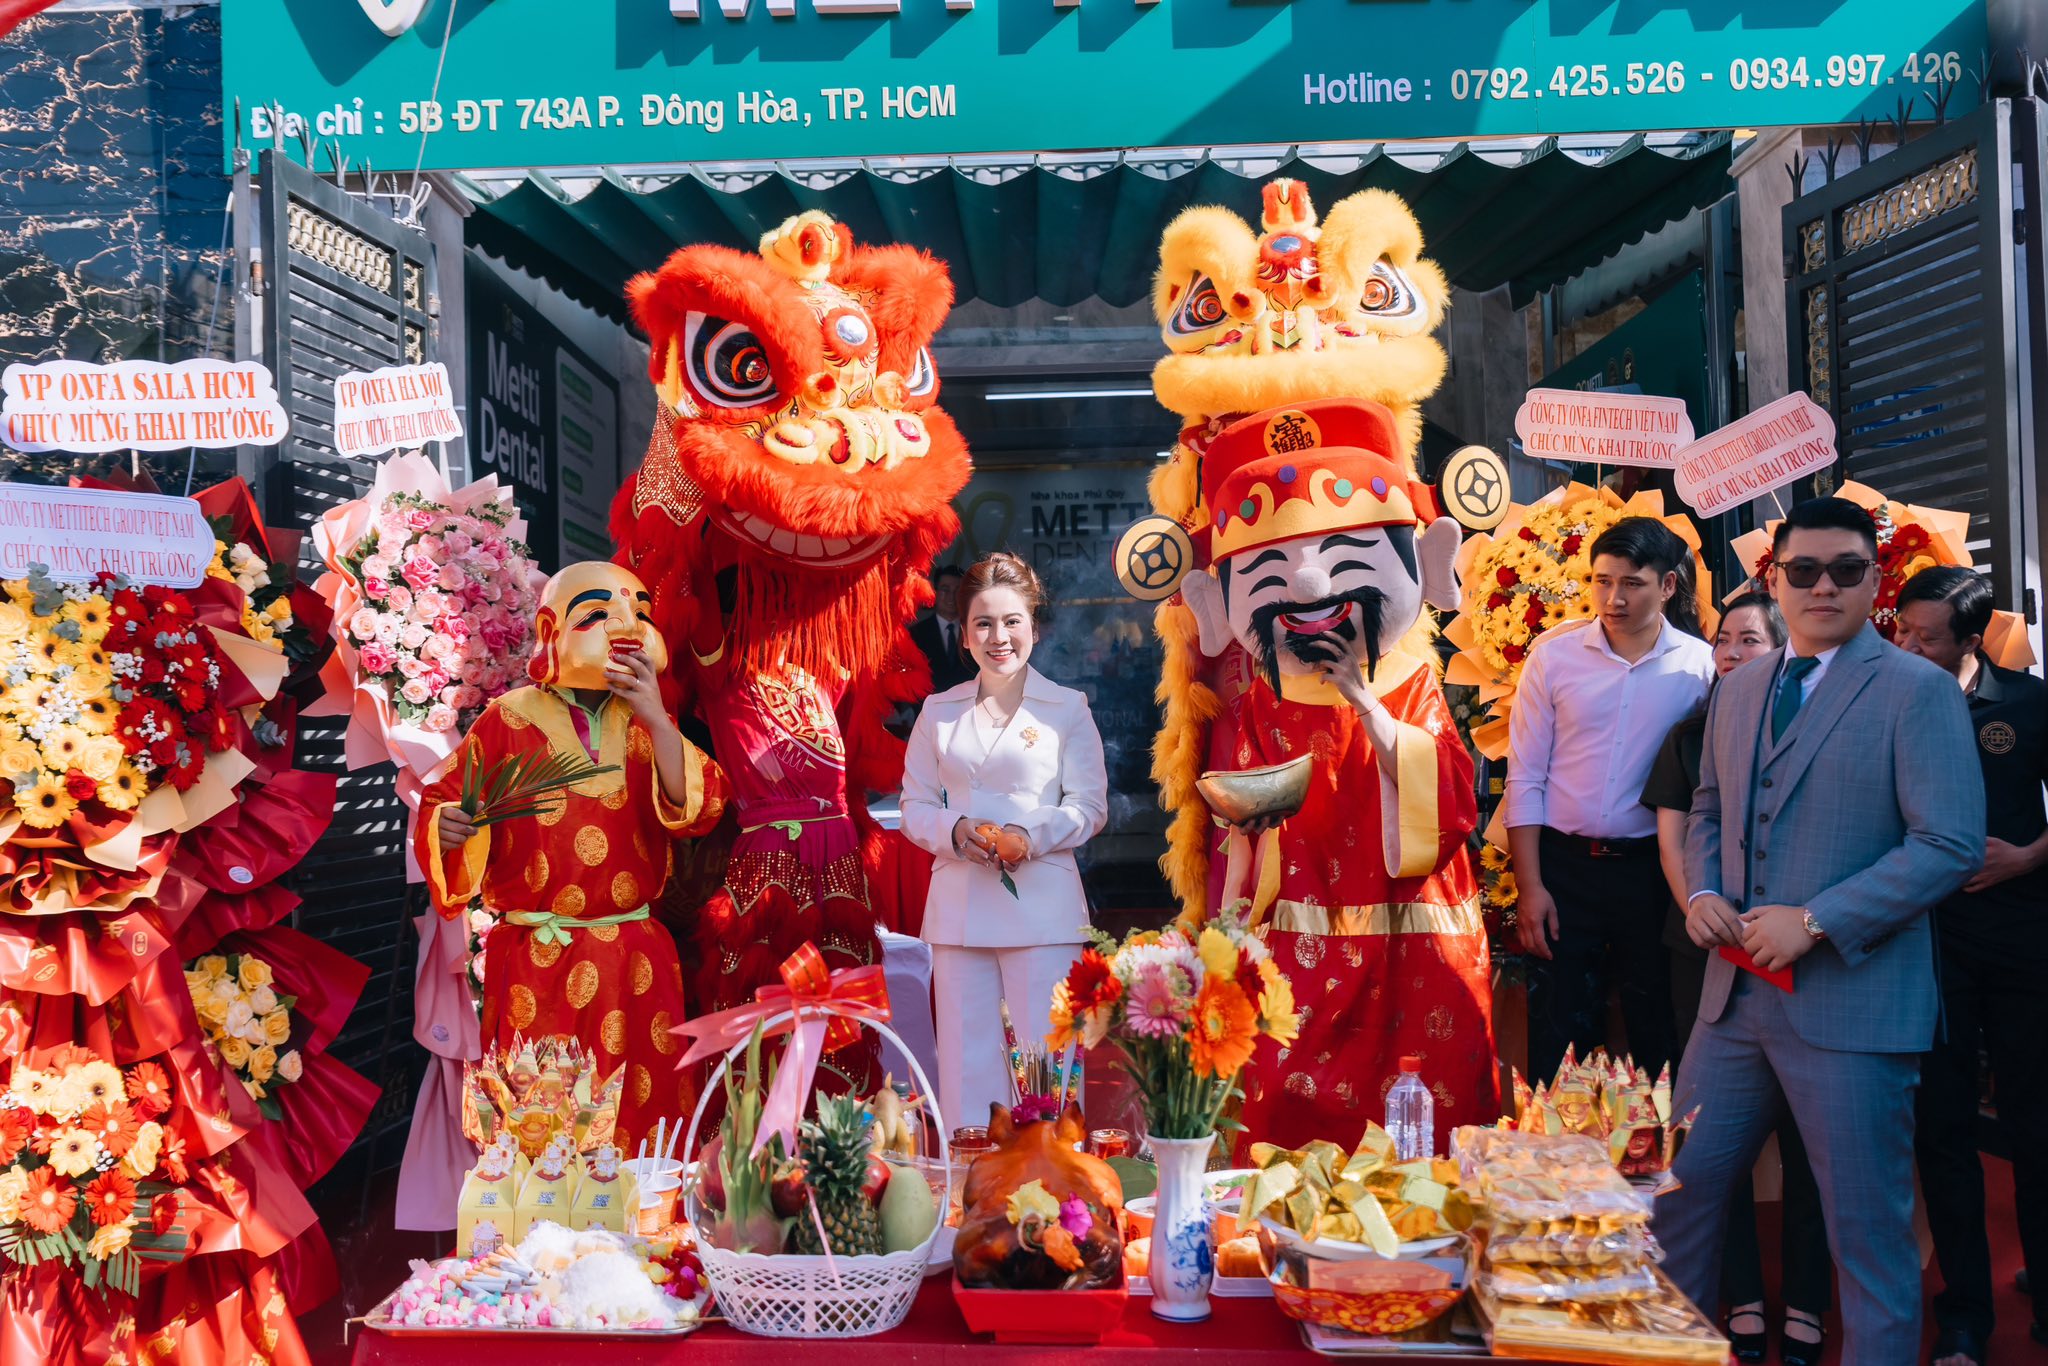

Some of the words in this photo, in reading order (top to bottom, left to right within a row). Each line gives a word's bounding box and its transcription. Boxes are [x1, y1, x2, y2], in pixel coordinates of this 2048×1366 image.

[1303, 72, 1412, 105] Hotline
[1451, 61, 1685, 101] 0792.425.526
[1729, 51, 1962, 91] 0934.997.426
[316, 97, 363, 136] chỉ
[399, 100, 443, 134] 5B
[452, 99, 503, 132] ĐT
[516, 97, 592, 131] 743A
[598, 95, 623, 128] P.
[640, 93, 724, 133] Đông
[820, 87, 867, 120] TP.
[882, 84, 956, 119] HCM
[18, 373, 51, 401] VP
[61, 372, 126, 401] ONFA
[133, 371, 196, 400] SALA
[203, 371, 255, 399] HCM
[340, 381, 357, 408] VP
[361, 377, 397, 407] ONFA
[397, 368, 419, 401] HÀ
[419, 366, 443, 406] NỘI
[487, 330, 540, 427] Metti
[8, 406, 64, 443] CHÚC
[71, 405, 128, 442] MỪNG
[136, 411, 186, 442] KHAI
[192, 406, 274, 440] TRƯƠNG
[393, 413, 418, 442] KHAI
[1530, 395, 1556, 425] CÔNG
[1556, 404, 1569, 425] TY
[1569, 405, 1592, 428] ONFA
[1593, 406, 1632, 431] FINTECH
[1634, 407, 1656, 437] VIỆT
[1657, 411, 1679, 434] NAM
[479, 397, 548, 494] Dental
[1530, 428, 1561, 452] CHÚC
[1562, 430, 1596, 455] MỪNG
[1598, 438, 1626, 458] KHAI
[1681, 456, 1706, 485] CÔNG
[1703, 454, 1715, 476] TY
[1747, 424, 1777, 455] GROUP
[1696, 481, 1727, 511] CHÚC
[1724, 471, 1758, 500] MỪNG
[1753, 458, 1786, 486] KHAI
[31, 501, 45, 529] TY
[47, 502, 111, 533] METTITECH
[112, 506, 146, 535] GROUP
[146, 507, 170, 543] VIỆT
[171, 513, 195, 539] NAM
[4, 536, 47, 569] CHÚC
[51, 538, 96, 573] MỪNG
[100, 548, 136, 575] KHAI
